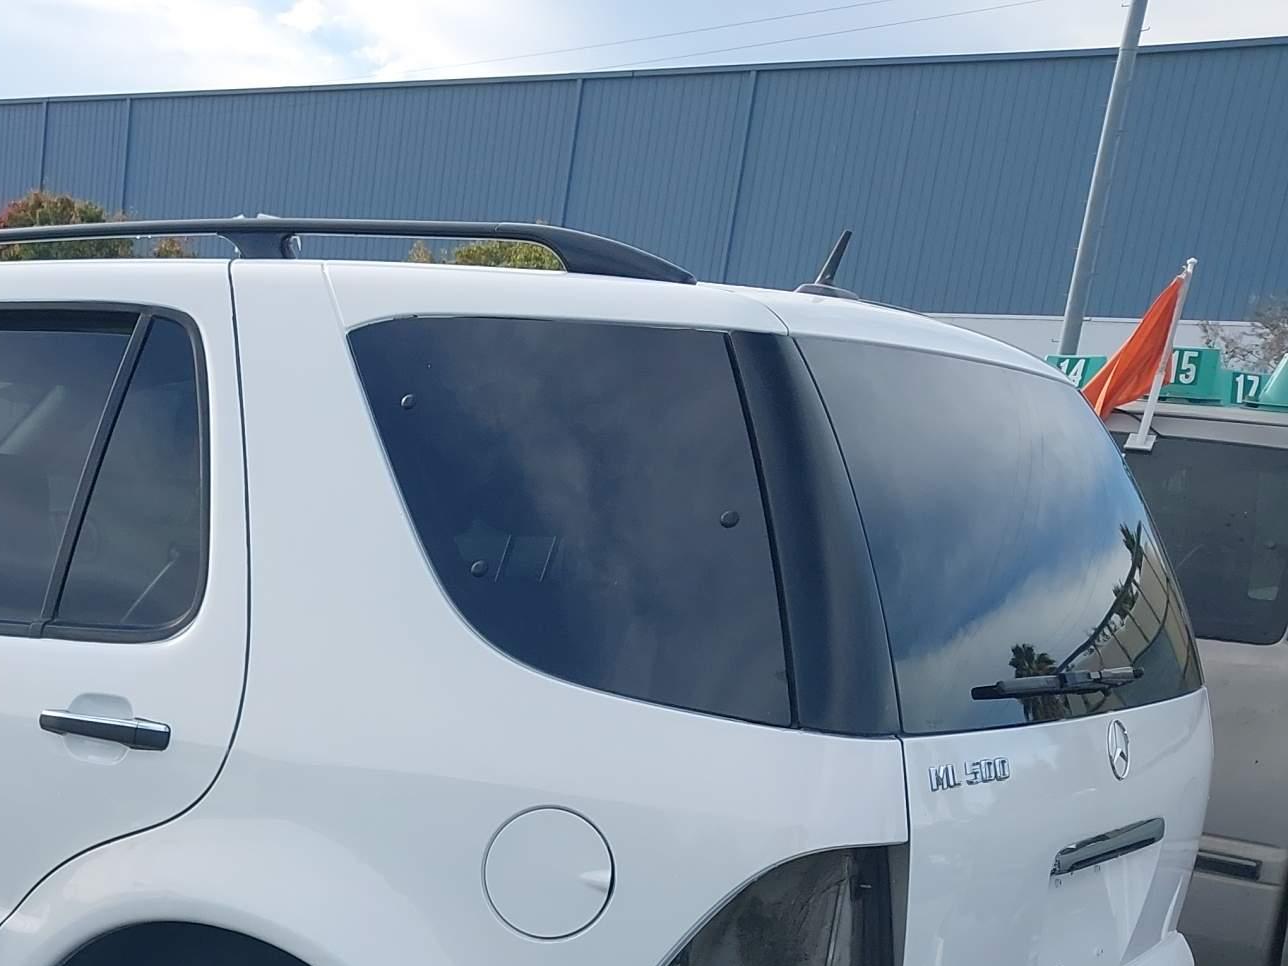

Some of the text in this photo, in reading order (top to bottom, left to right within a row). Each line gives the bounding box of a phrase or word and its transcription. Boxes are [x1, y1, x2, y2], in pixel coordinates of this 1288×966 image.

[1170, 350, 1199, 384] 15
[1235, 373, 1260, 404] 17
[928, 757, 1010, 792] ML 500
